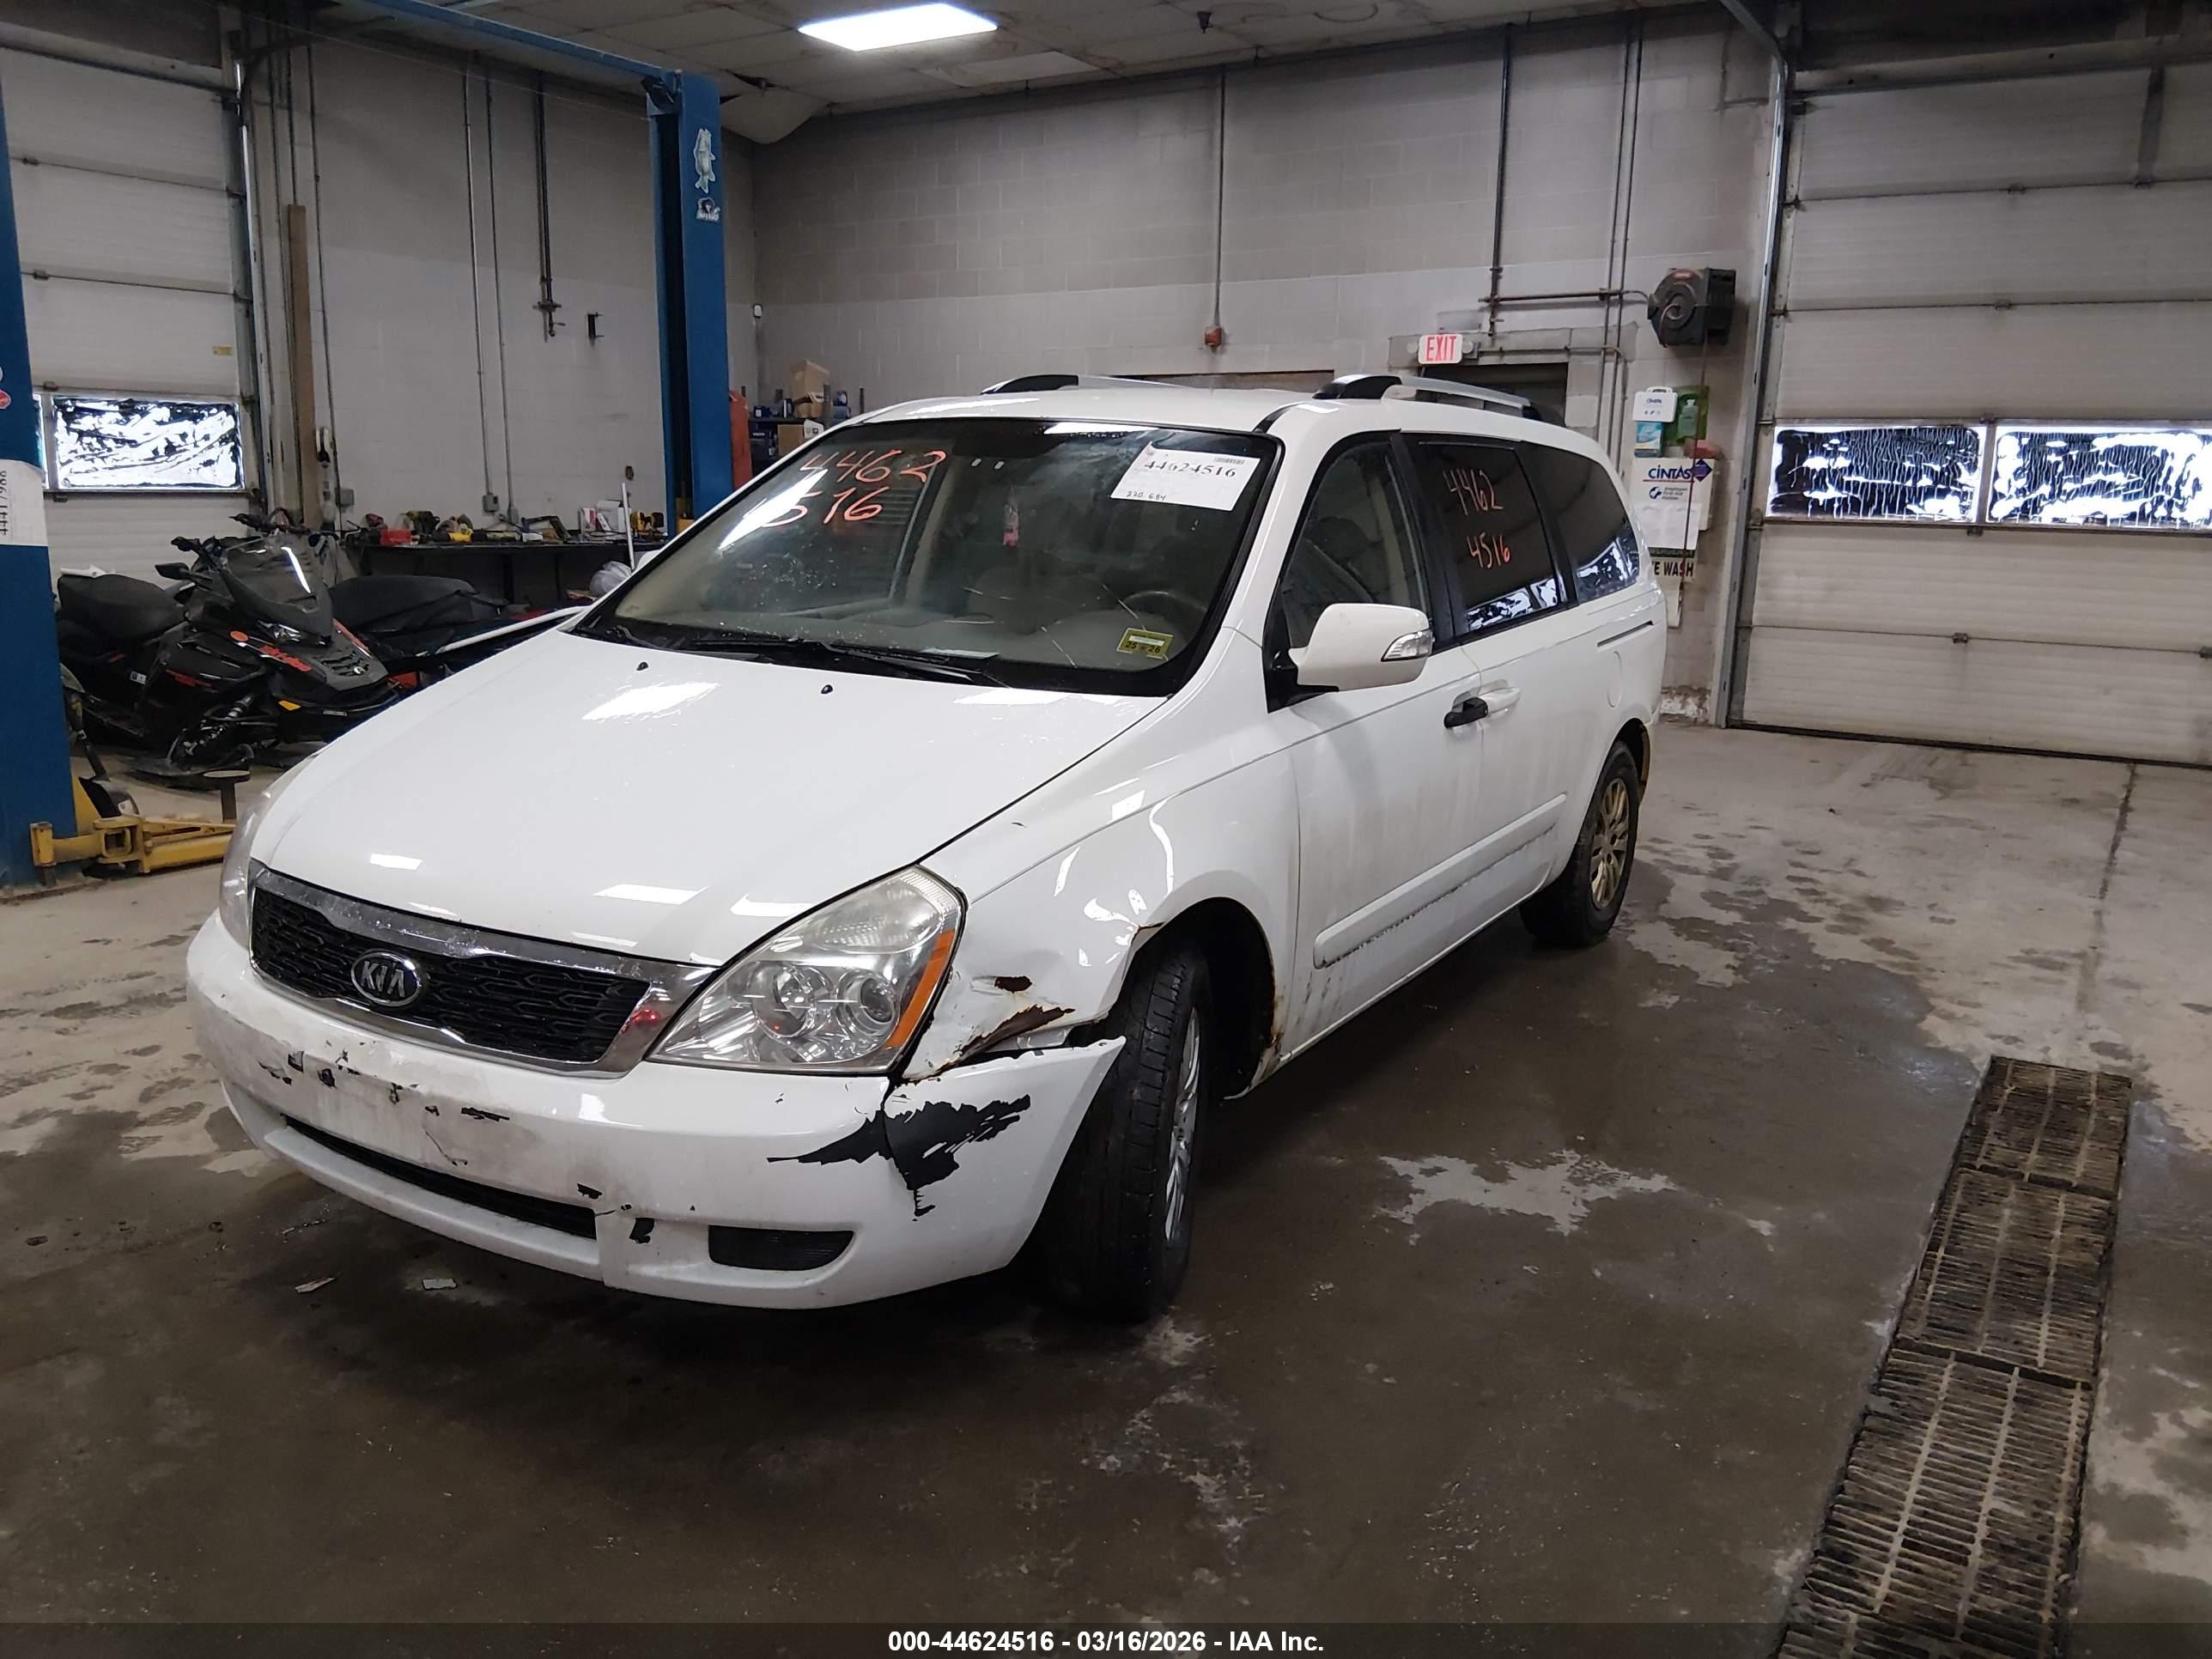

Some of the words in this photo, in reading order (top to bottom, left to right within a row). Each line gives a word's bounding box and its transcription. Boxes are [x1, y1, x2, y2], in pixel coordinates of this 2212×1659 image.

[1426, 336, 1457, 361] EXIT
[799, 450, 946, 483] 4462
[1443, 468, 1504, 515] 4462
[1467, 532, 1511, 568] 4516
[1664, 561, 1694, 577] WASH
[1125, 641, 1137, 649] 25
[1148, 645, 1161, 653] 26
[361, 961, 405, 998] KIA
